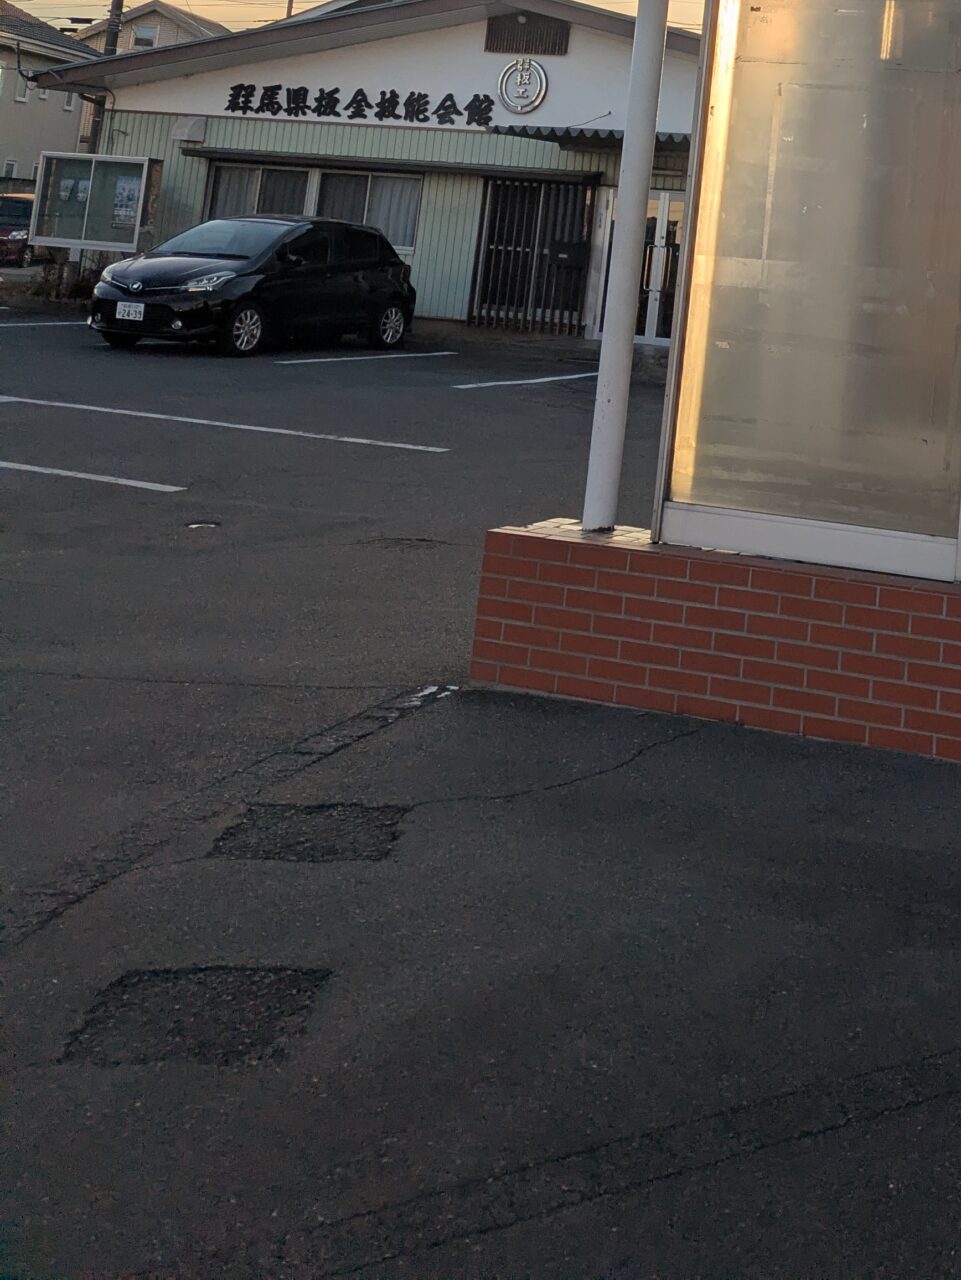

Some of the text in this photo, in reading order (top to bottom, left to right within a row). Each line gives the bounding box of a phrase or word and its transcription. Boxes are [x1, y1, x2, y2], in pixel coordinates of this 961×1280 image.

[224, 83, 496, 127] 群馬県板金技能会館
